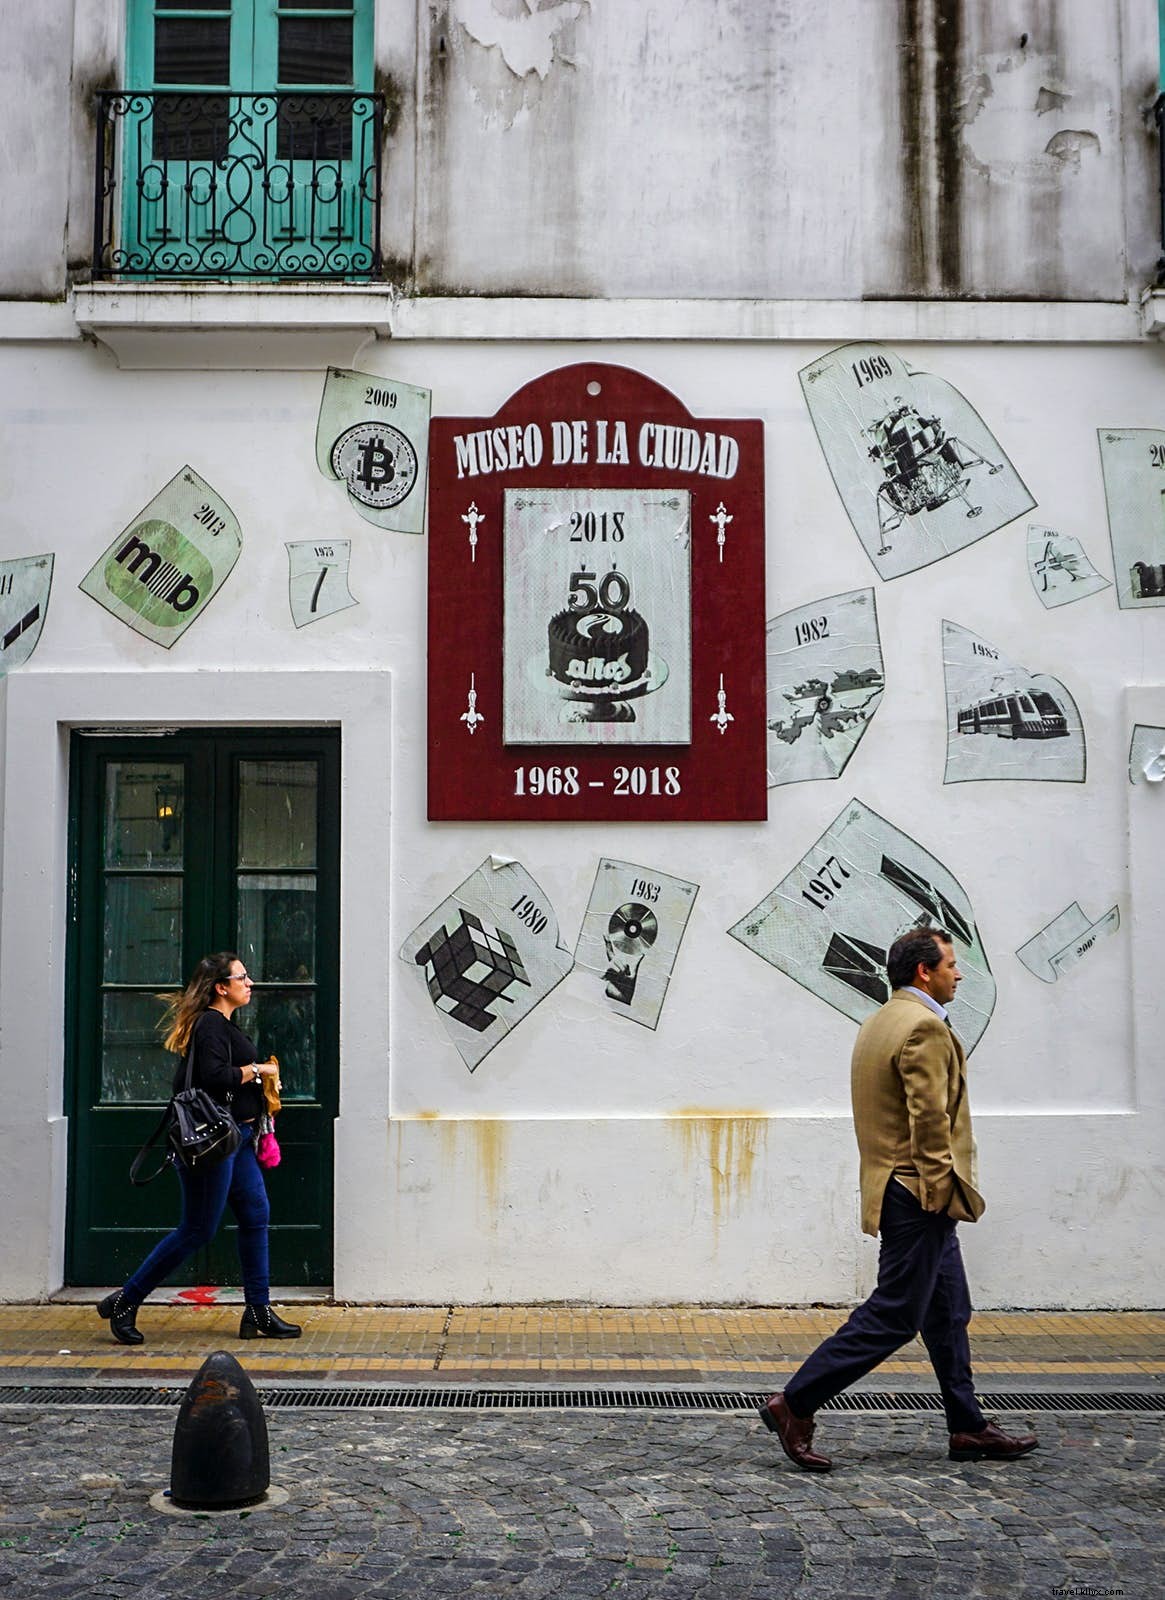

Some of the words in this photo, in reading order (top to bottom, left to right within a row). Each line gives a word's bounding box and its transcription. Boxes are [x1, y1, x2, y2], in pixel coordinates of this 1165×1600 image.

[851, 354, 893, 388] 1969
[364, 386, 398, 409] 2009
[453, 422, 543, 479] MUSEO
[551, 420, 588, 465] DE
[596, 420, 630, 465] LA
[639, 422, 740, 480] CIUDAD
[193, 502, 226, 536] 2013
[569, 511, 625, 543] 2018
[313, 546, 335, 557] 1975
[567, 571, 631, 613] 50
[795, 615, 829, 646] 1982
[513, 766, 581, 796] 1968
[613, 766, 682, 796] 2018
[630, 878, 662, 903] 1983
[802, 855, 850, 911] 1977
[510, 894, 549, 936] 1980
